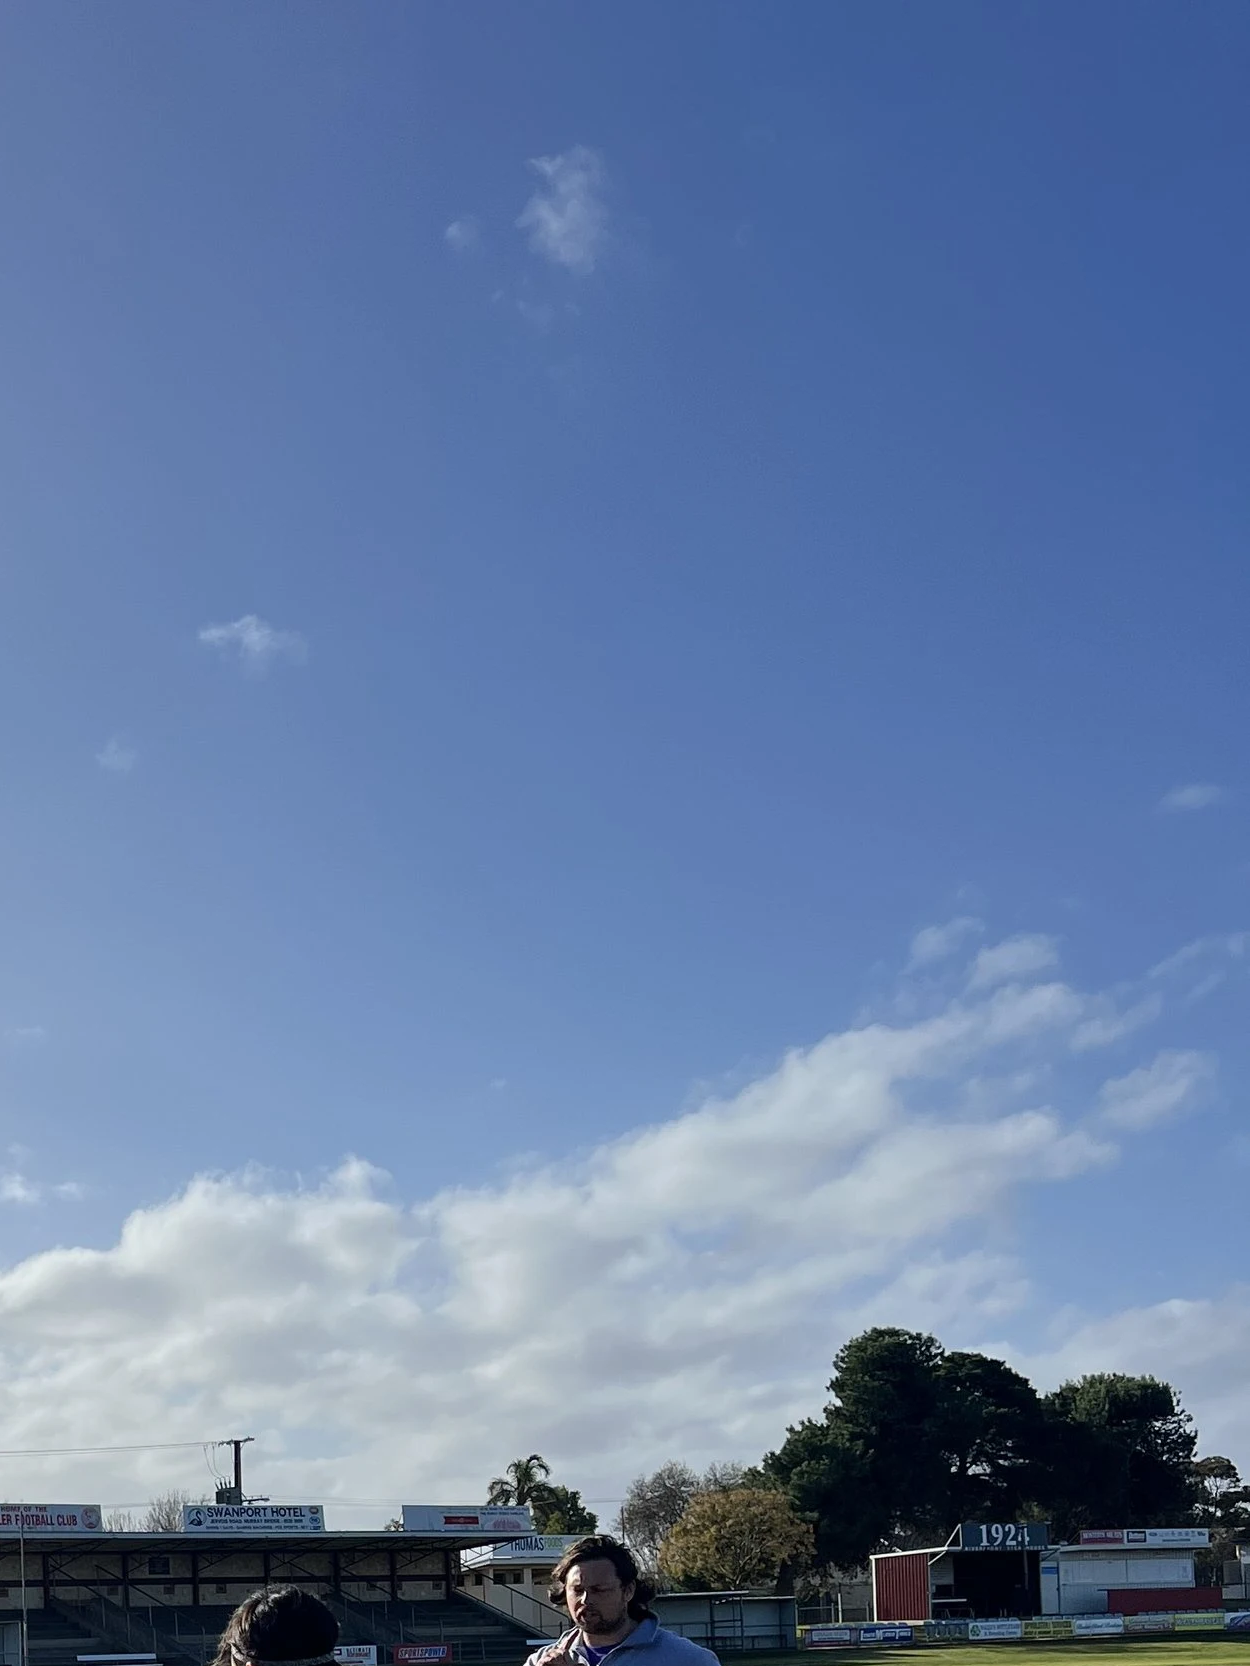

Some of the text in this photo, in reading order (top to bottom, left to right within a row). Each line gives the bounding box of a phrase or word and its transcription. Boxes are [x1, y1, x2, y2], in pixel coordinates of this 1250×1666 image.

[0, 1505, 20, 1513] HOME
[206, 1507, 306, 1518] SWANPORT HOTEL
[15, 1513, 55, 1526] FOOTBALL
[56, 1514, 78, 1526] CLUB
[979, 1523, 1030, 1546] 1924
[510, 1537, 563, 1551] THOMAS FOODS
